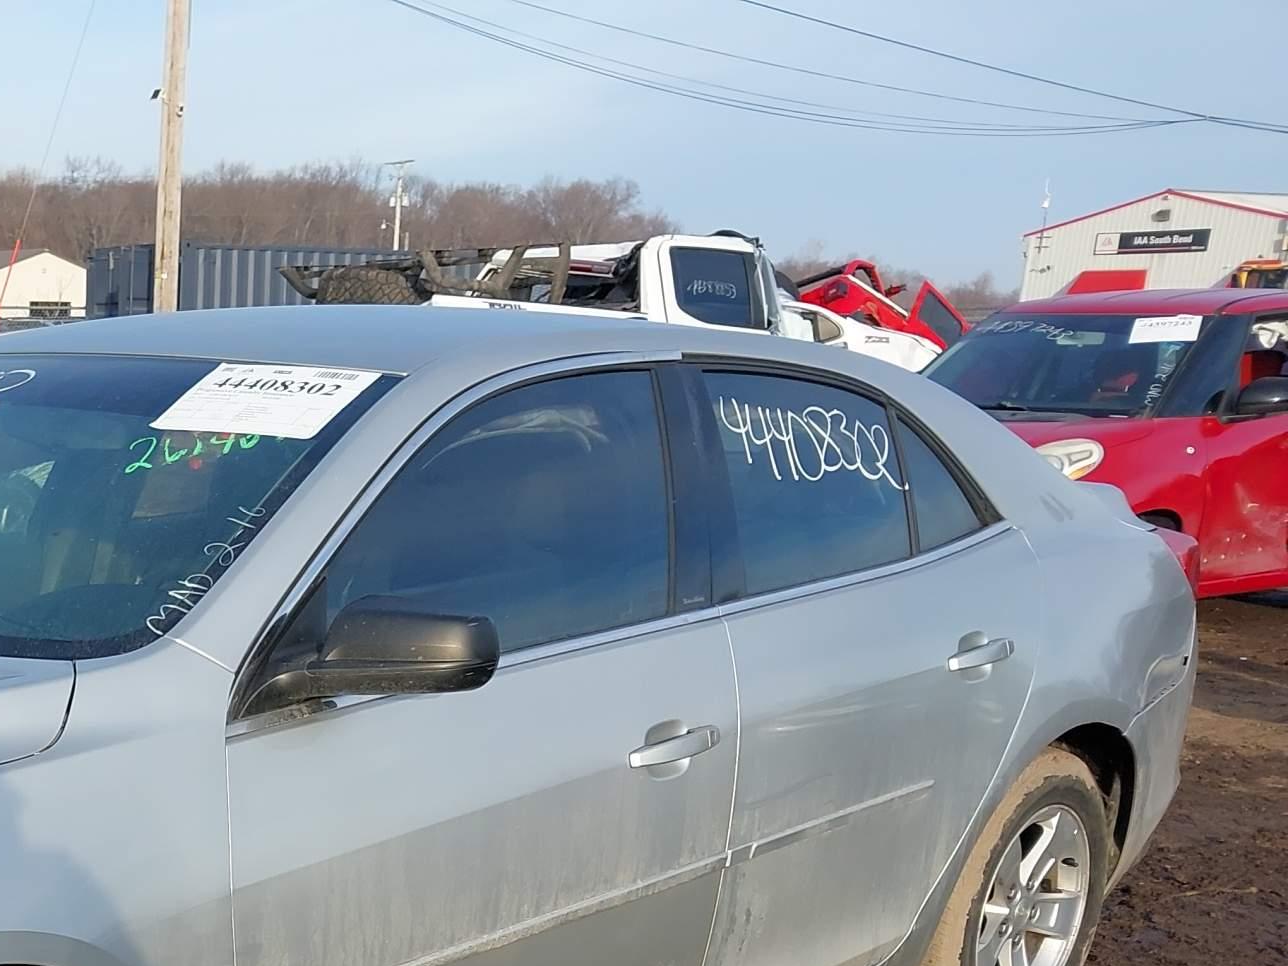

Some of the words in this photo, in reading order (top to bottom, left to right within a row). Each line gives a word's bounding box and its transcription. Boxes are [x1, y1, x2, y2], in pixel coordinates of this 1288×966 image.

[1172, 234, 1193, 243] Bend
[212, 376, 343, 396] 44408302
[719, 396, 910, 491] 44408302
[203, 505, 266, 567] 2-16
